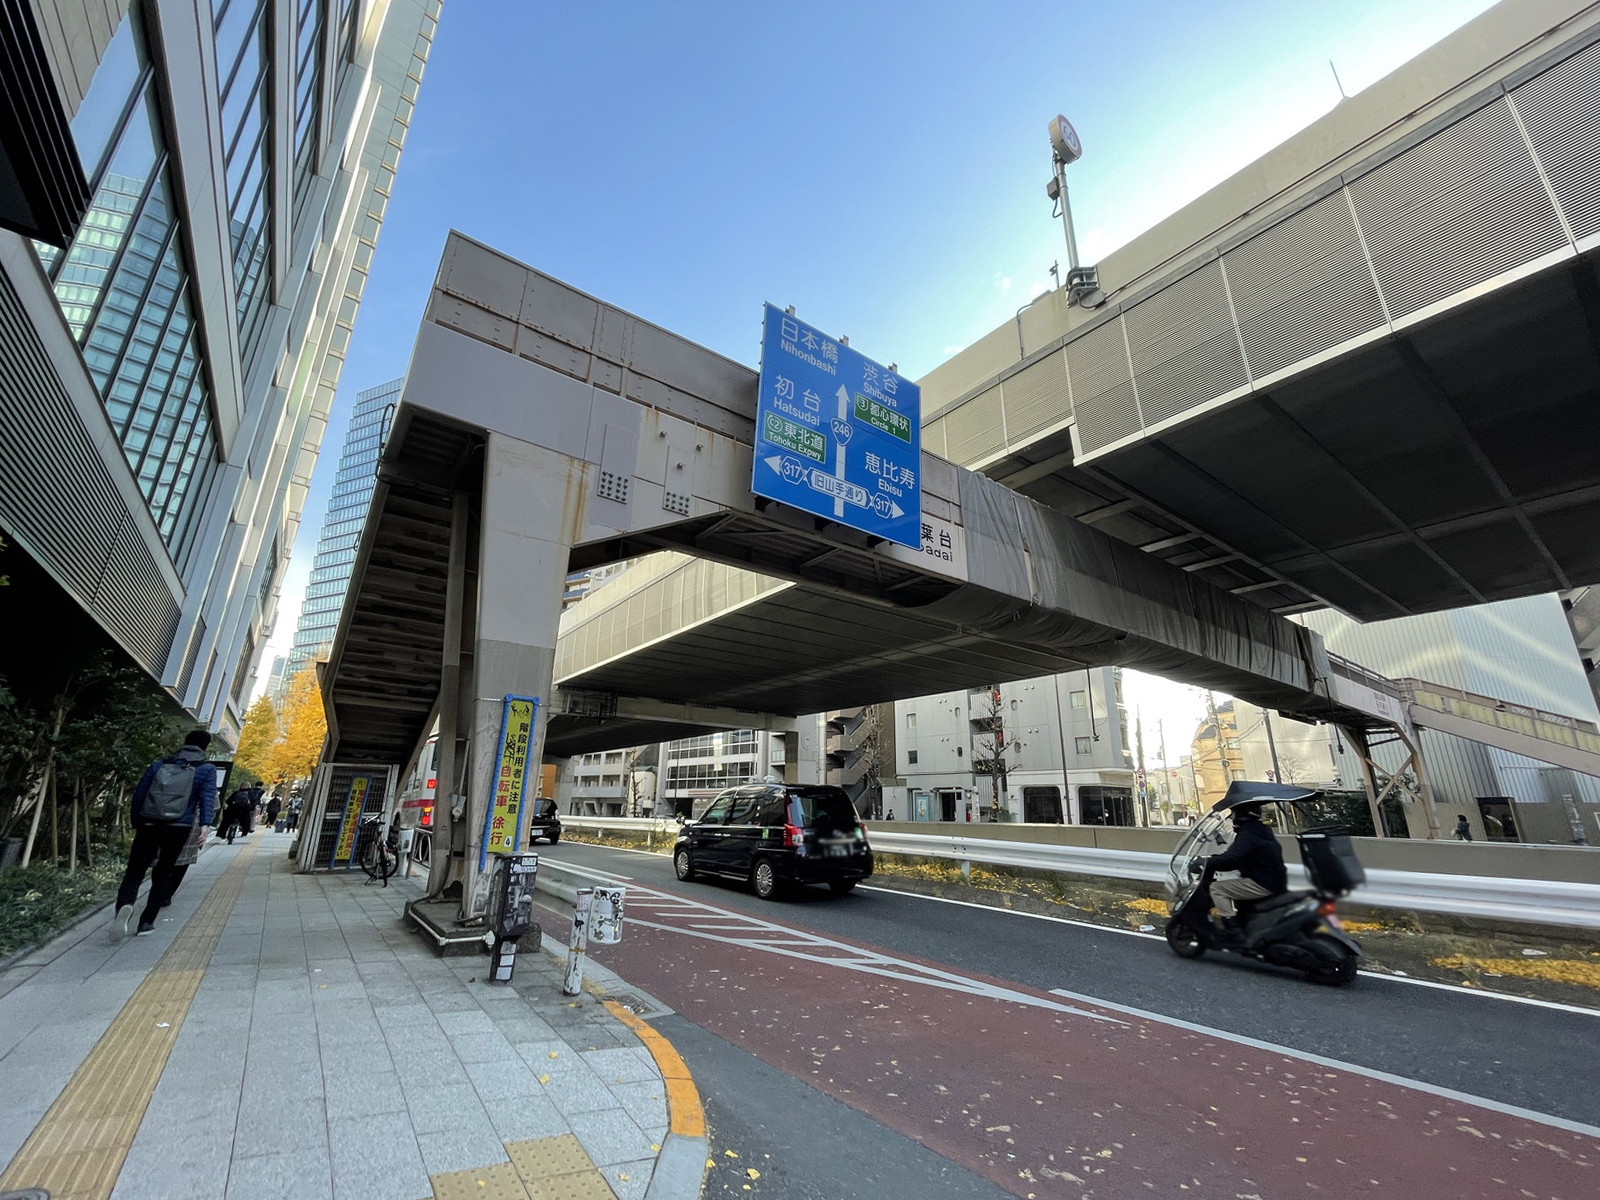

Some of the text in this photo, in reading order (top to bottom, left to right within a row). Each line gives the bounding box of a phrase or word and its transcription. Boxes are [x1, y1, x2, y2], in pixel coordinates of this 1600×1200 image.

[781, 317, 839, 364] 日本橋
[780, 338, 837, 376] Nihonbashi
[774, 374, 822, 413] 初台
[863, 361, 899, 395] 渋谷
[863, 381, 898, 408] Shibuya
[773, 396, 821, 427] Hatsudai
[870, 416, 889, 431] Circle
[783, 421, 824, 451] 東北道
[833, 421, 850, 438] 246
[768, 431, 822, 460] Tohoku Expwy
[783, 461, 801, 478] 317
[865, 451, 916, 490] 恵比寿
[814, 472, 863, 503] 旧山手通り
[878, 478, 903, 498] Ebisu
[875, 497, 890, 513] 317
[921, 543, 953, 563] adai
[506, 722, 530, 816] 階段利用者に注意
[495, 764, 513, 808] 自転車
[490, 815, 506, 846] 徐行
